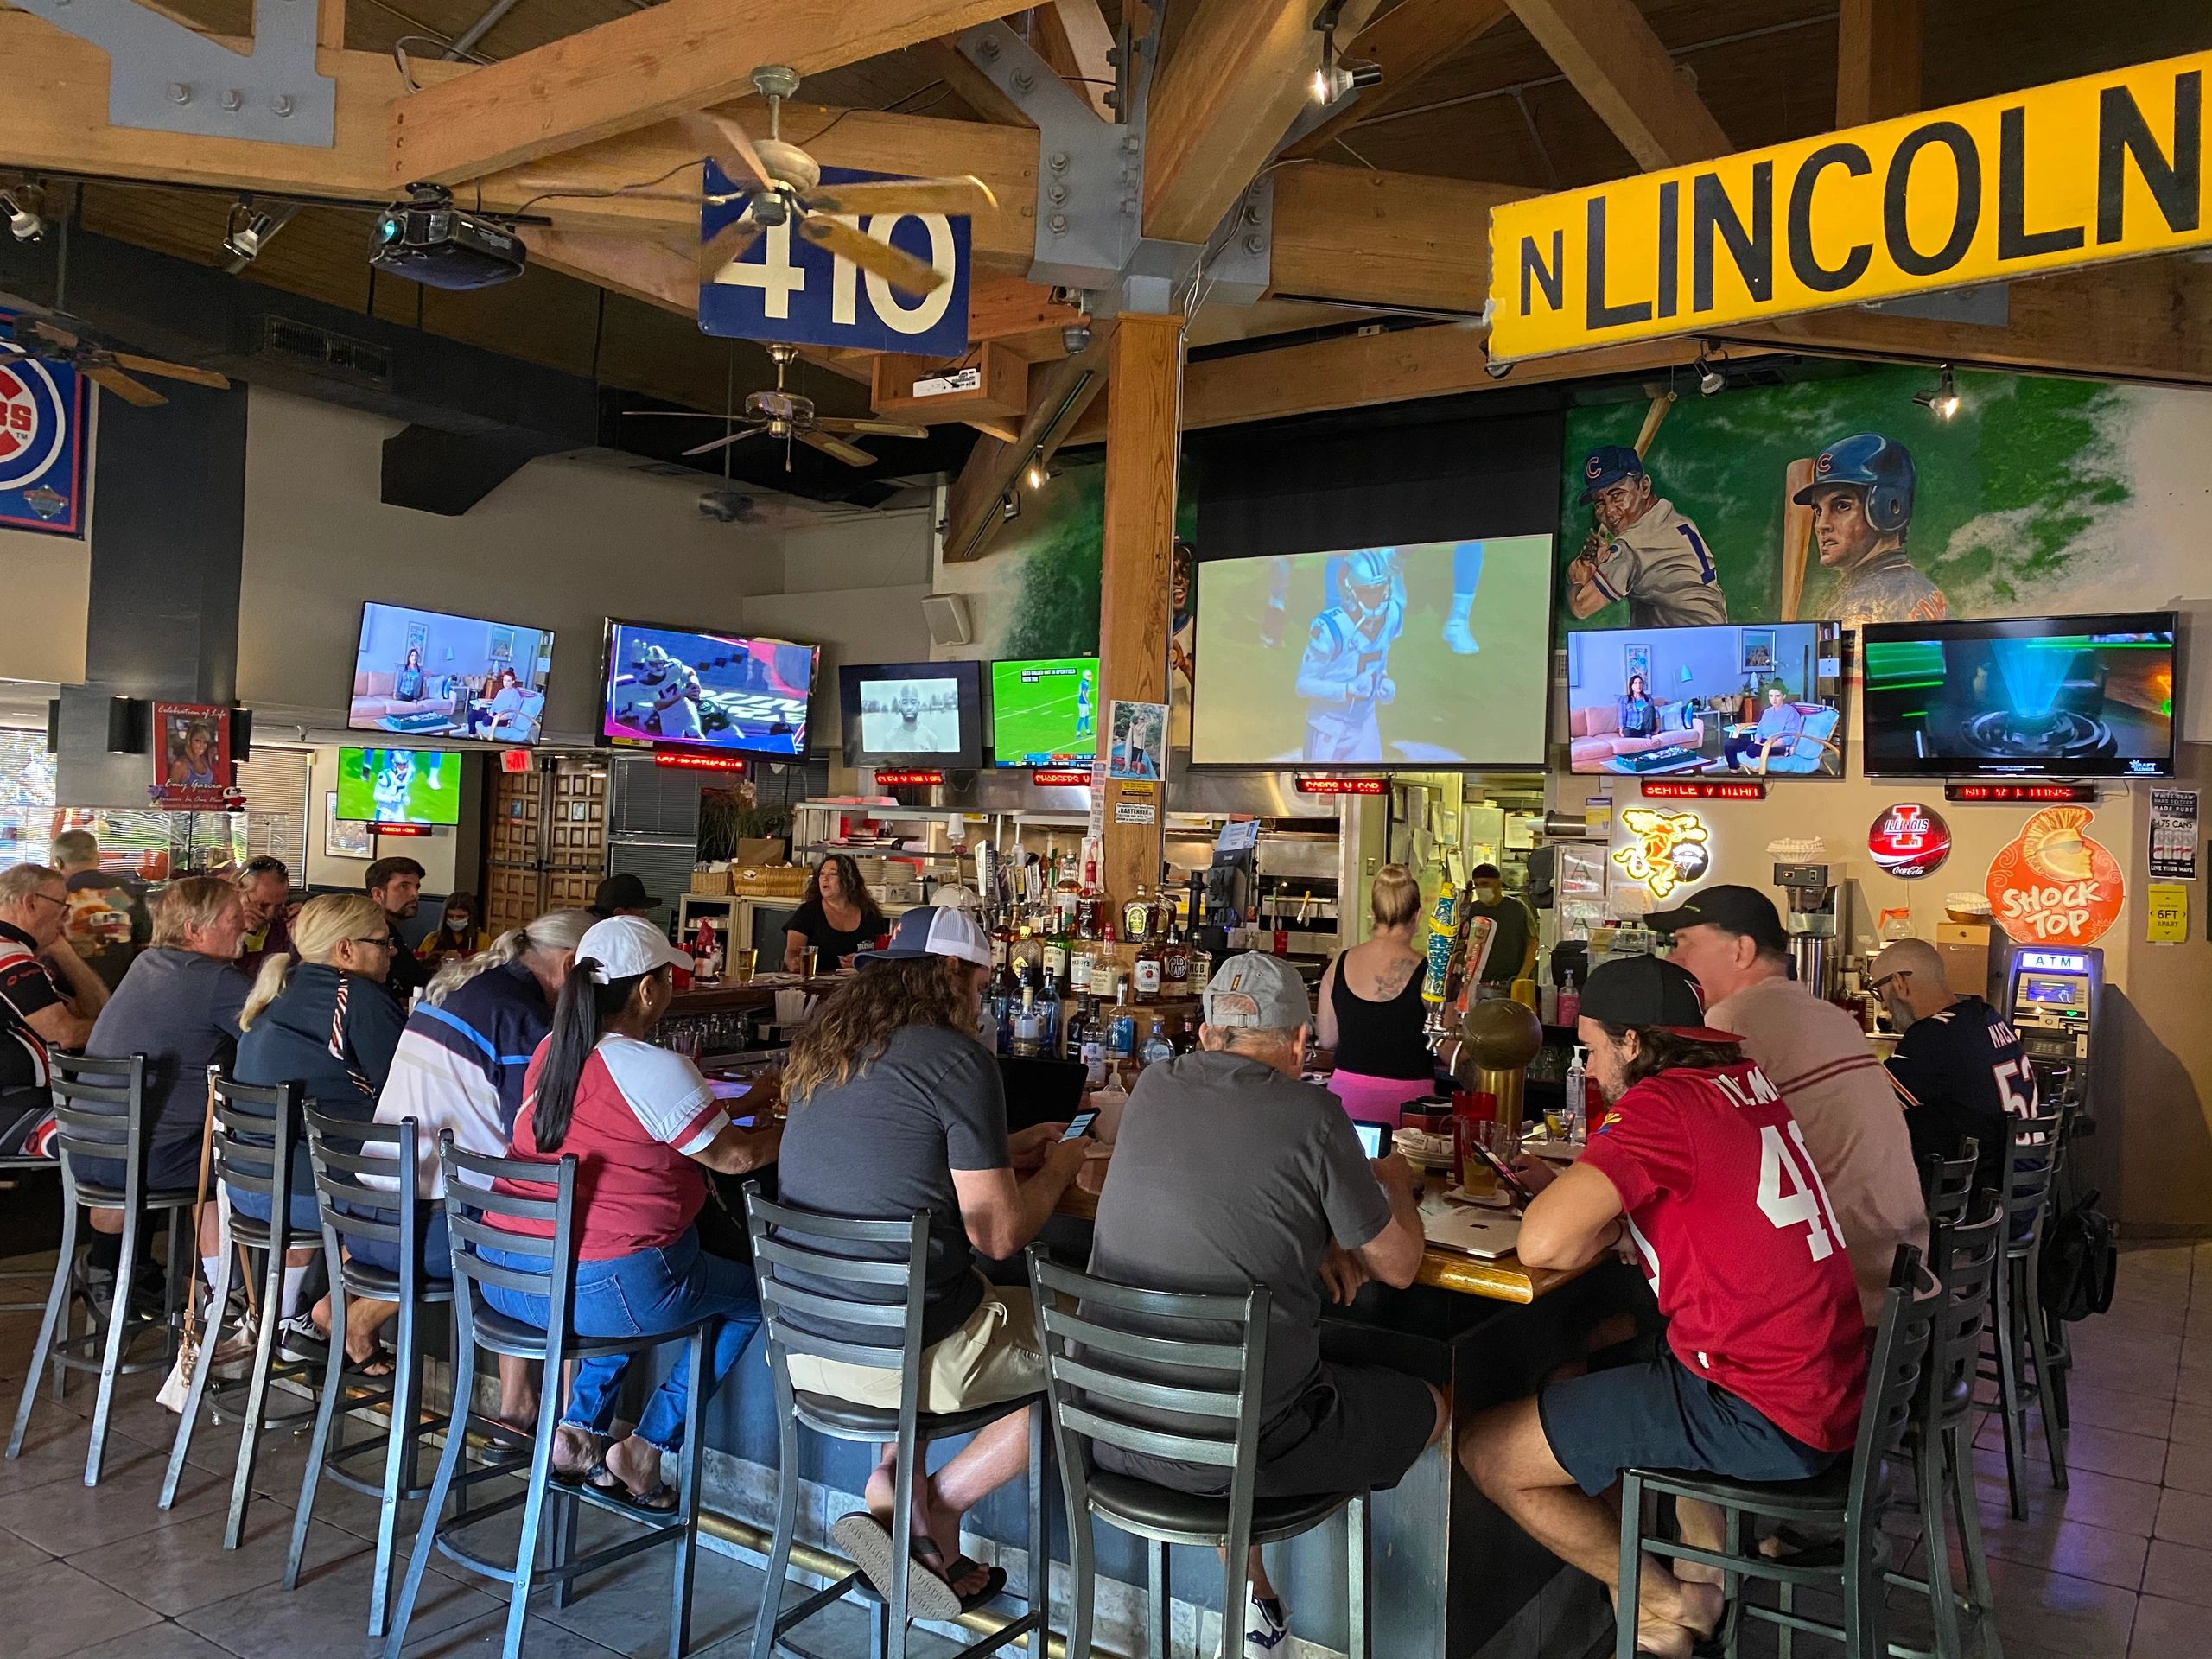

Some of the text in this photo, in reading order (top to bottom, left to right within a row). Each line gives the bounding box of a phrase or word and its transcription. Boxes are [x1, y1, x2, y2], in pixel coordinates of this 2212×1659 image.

[1519, 69, 2202, 330] N LINCOLN
[712, 202, 957, 334] 410
[158, 705, 226, 719] Celebration of Life
[1885, 819, 1929, 830] ILLINOIS
[2172, 820, 2193, 829] CANS
[2002, 880, 2104, 917] SHOCK
[2158, 909, 2178, 919] 6FT
[2024, 909, 2090, 939] TOP
[1172, 957, 1184, 966] OLD
[2036, 956, 2071, 967] ATM
[1189, 963, 1205, 973] NOB
